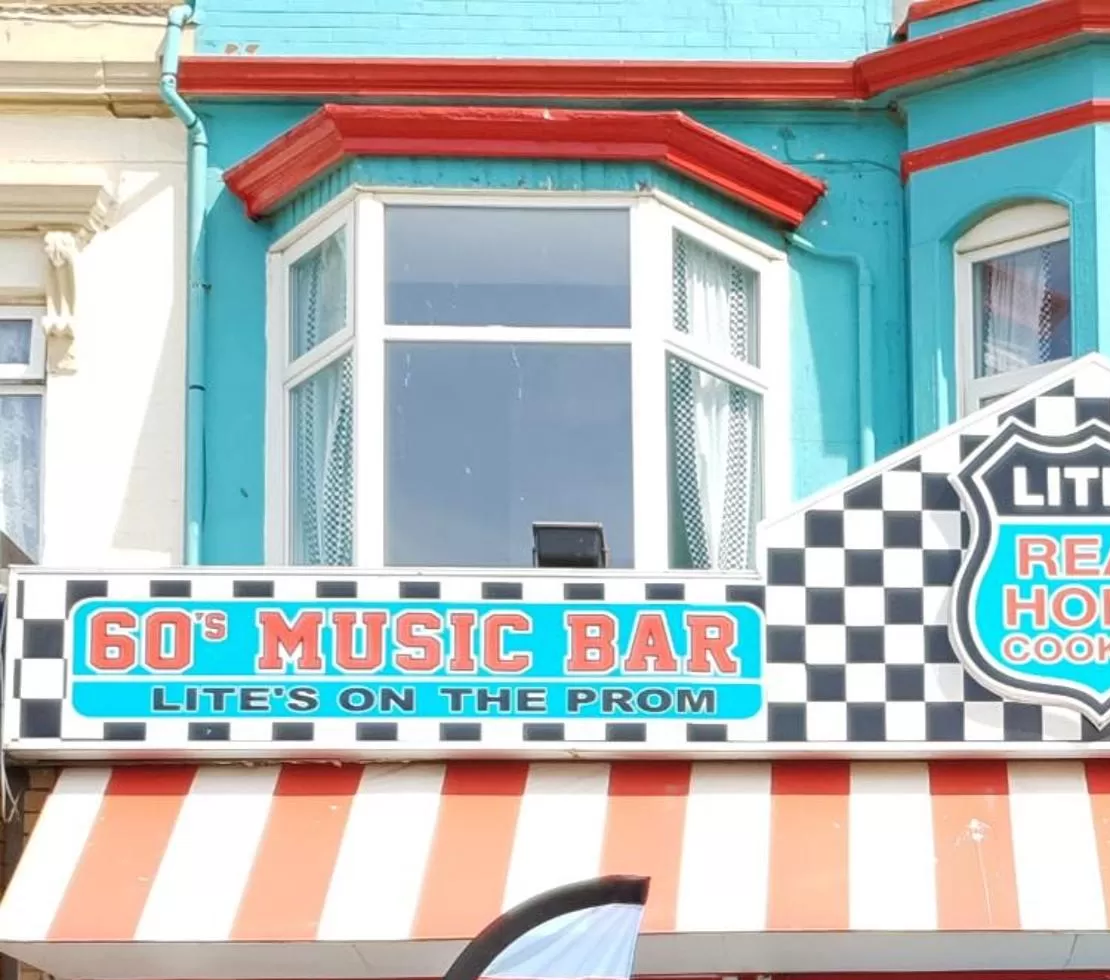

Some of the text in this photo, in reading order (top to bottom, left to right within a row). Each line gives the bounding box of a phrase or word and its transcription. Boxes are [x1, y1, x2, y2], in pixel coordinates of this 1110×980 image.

[257, 611, 530, 673] MUSIC
[566, 613, 738, 673] BAR
[152, 687, 717, 713] LITE'S ON THE PROM
